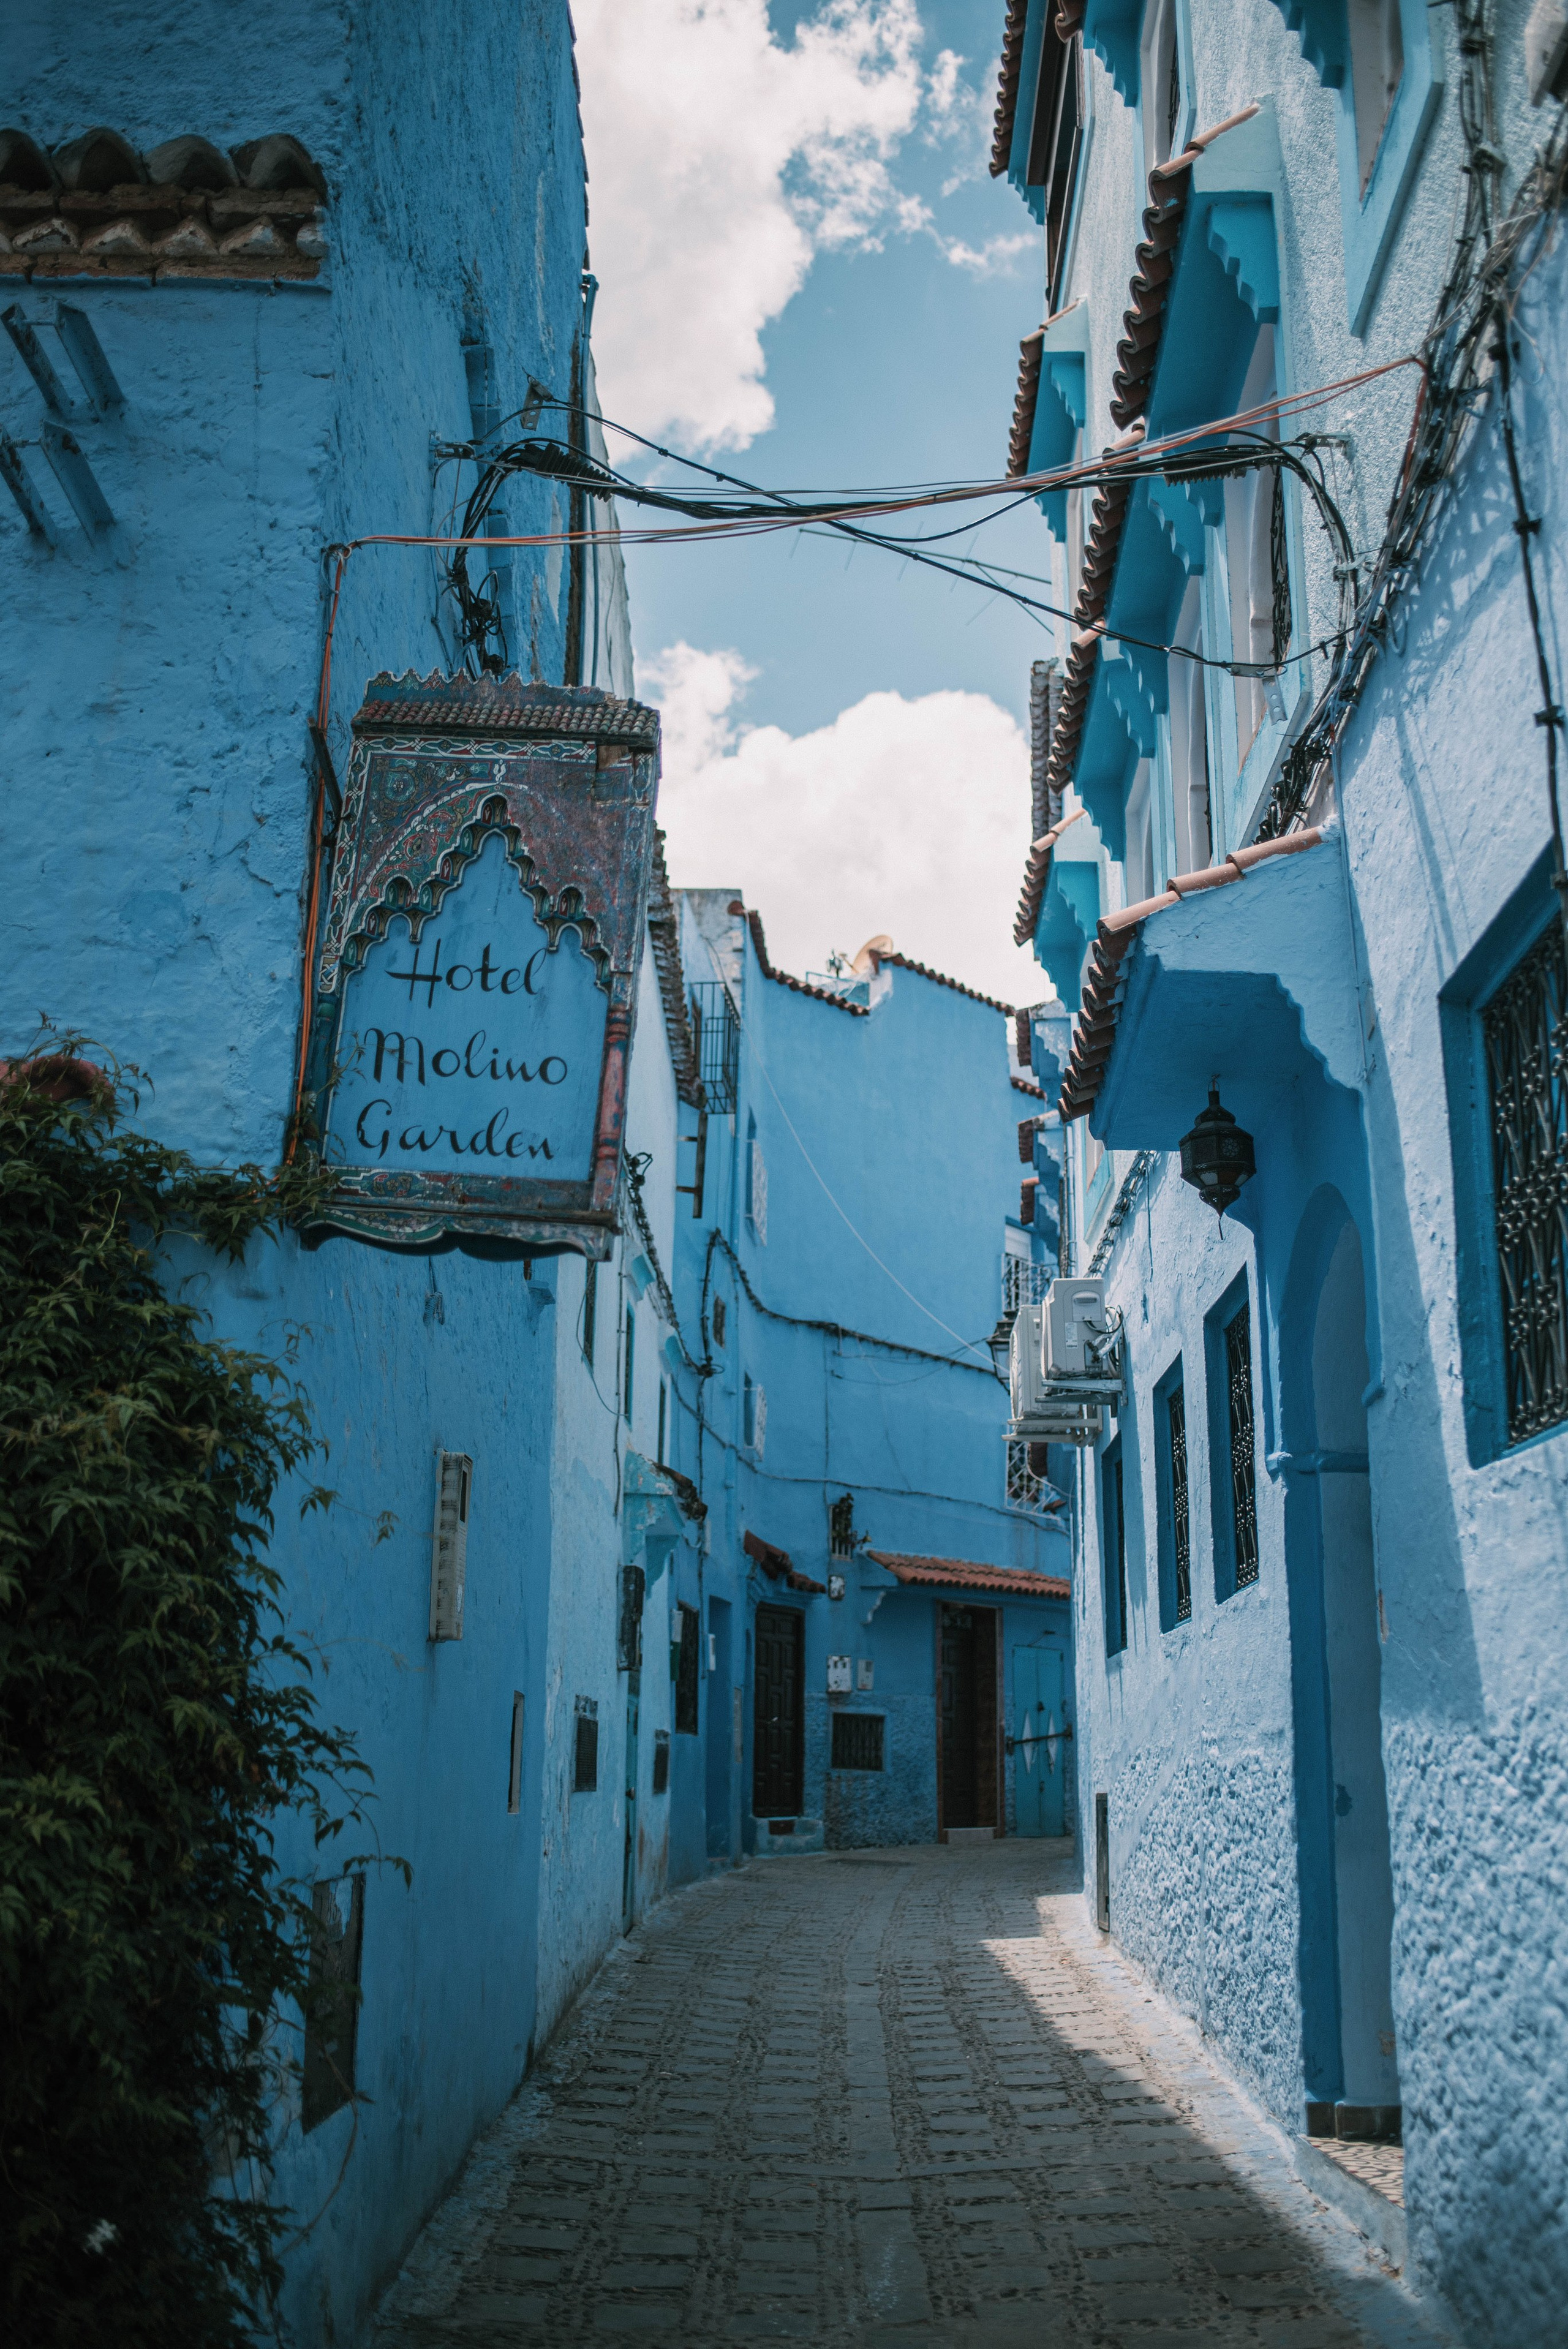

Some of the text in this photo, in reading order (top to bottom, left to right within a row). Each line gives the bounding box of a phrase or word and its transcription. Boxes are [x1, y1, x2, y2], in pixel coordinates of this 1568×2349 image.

[385, 938, 546, 1009] Hotel
[364, 1028, 567, 1086] Molino
[356, 1099, 554, 1160] Garden
